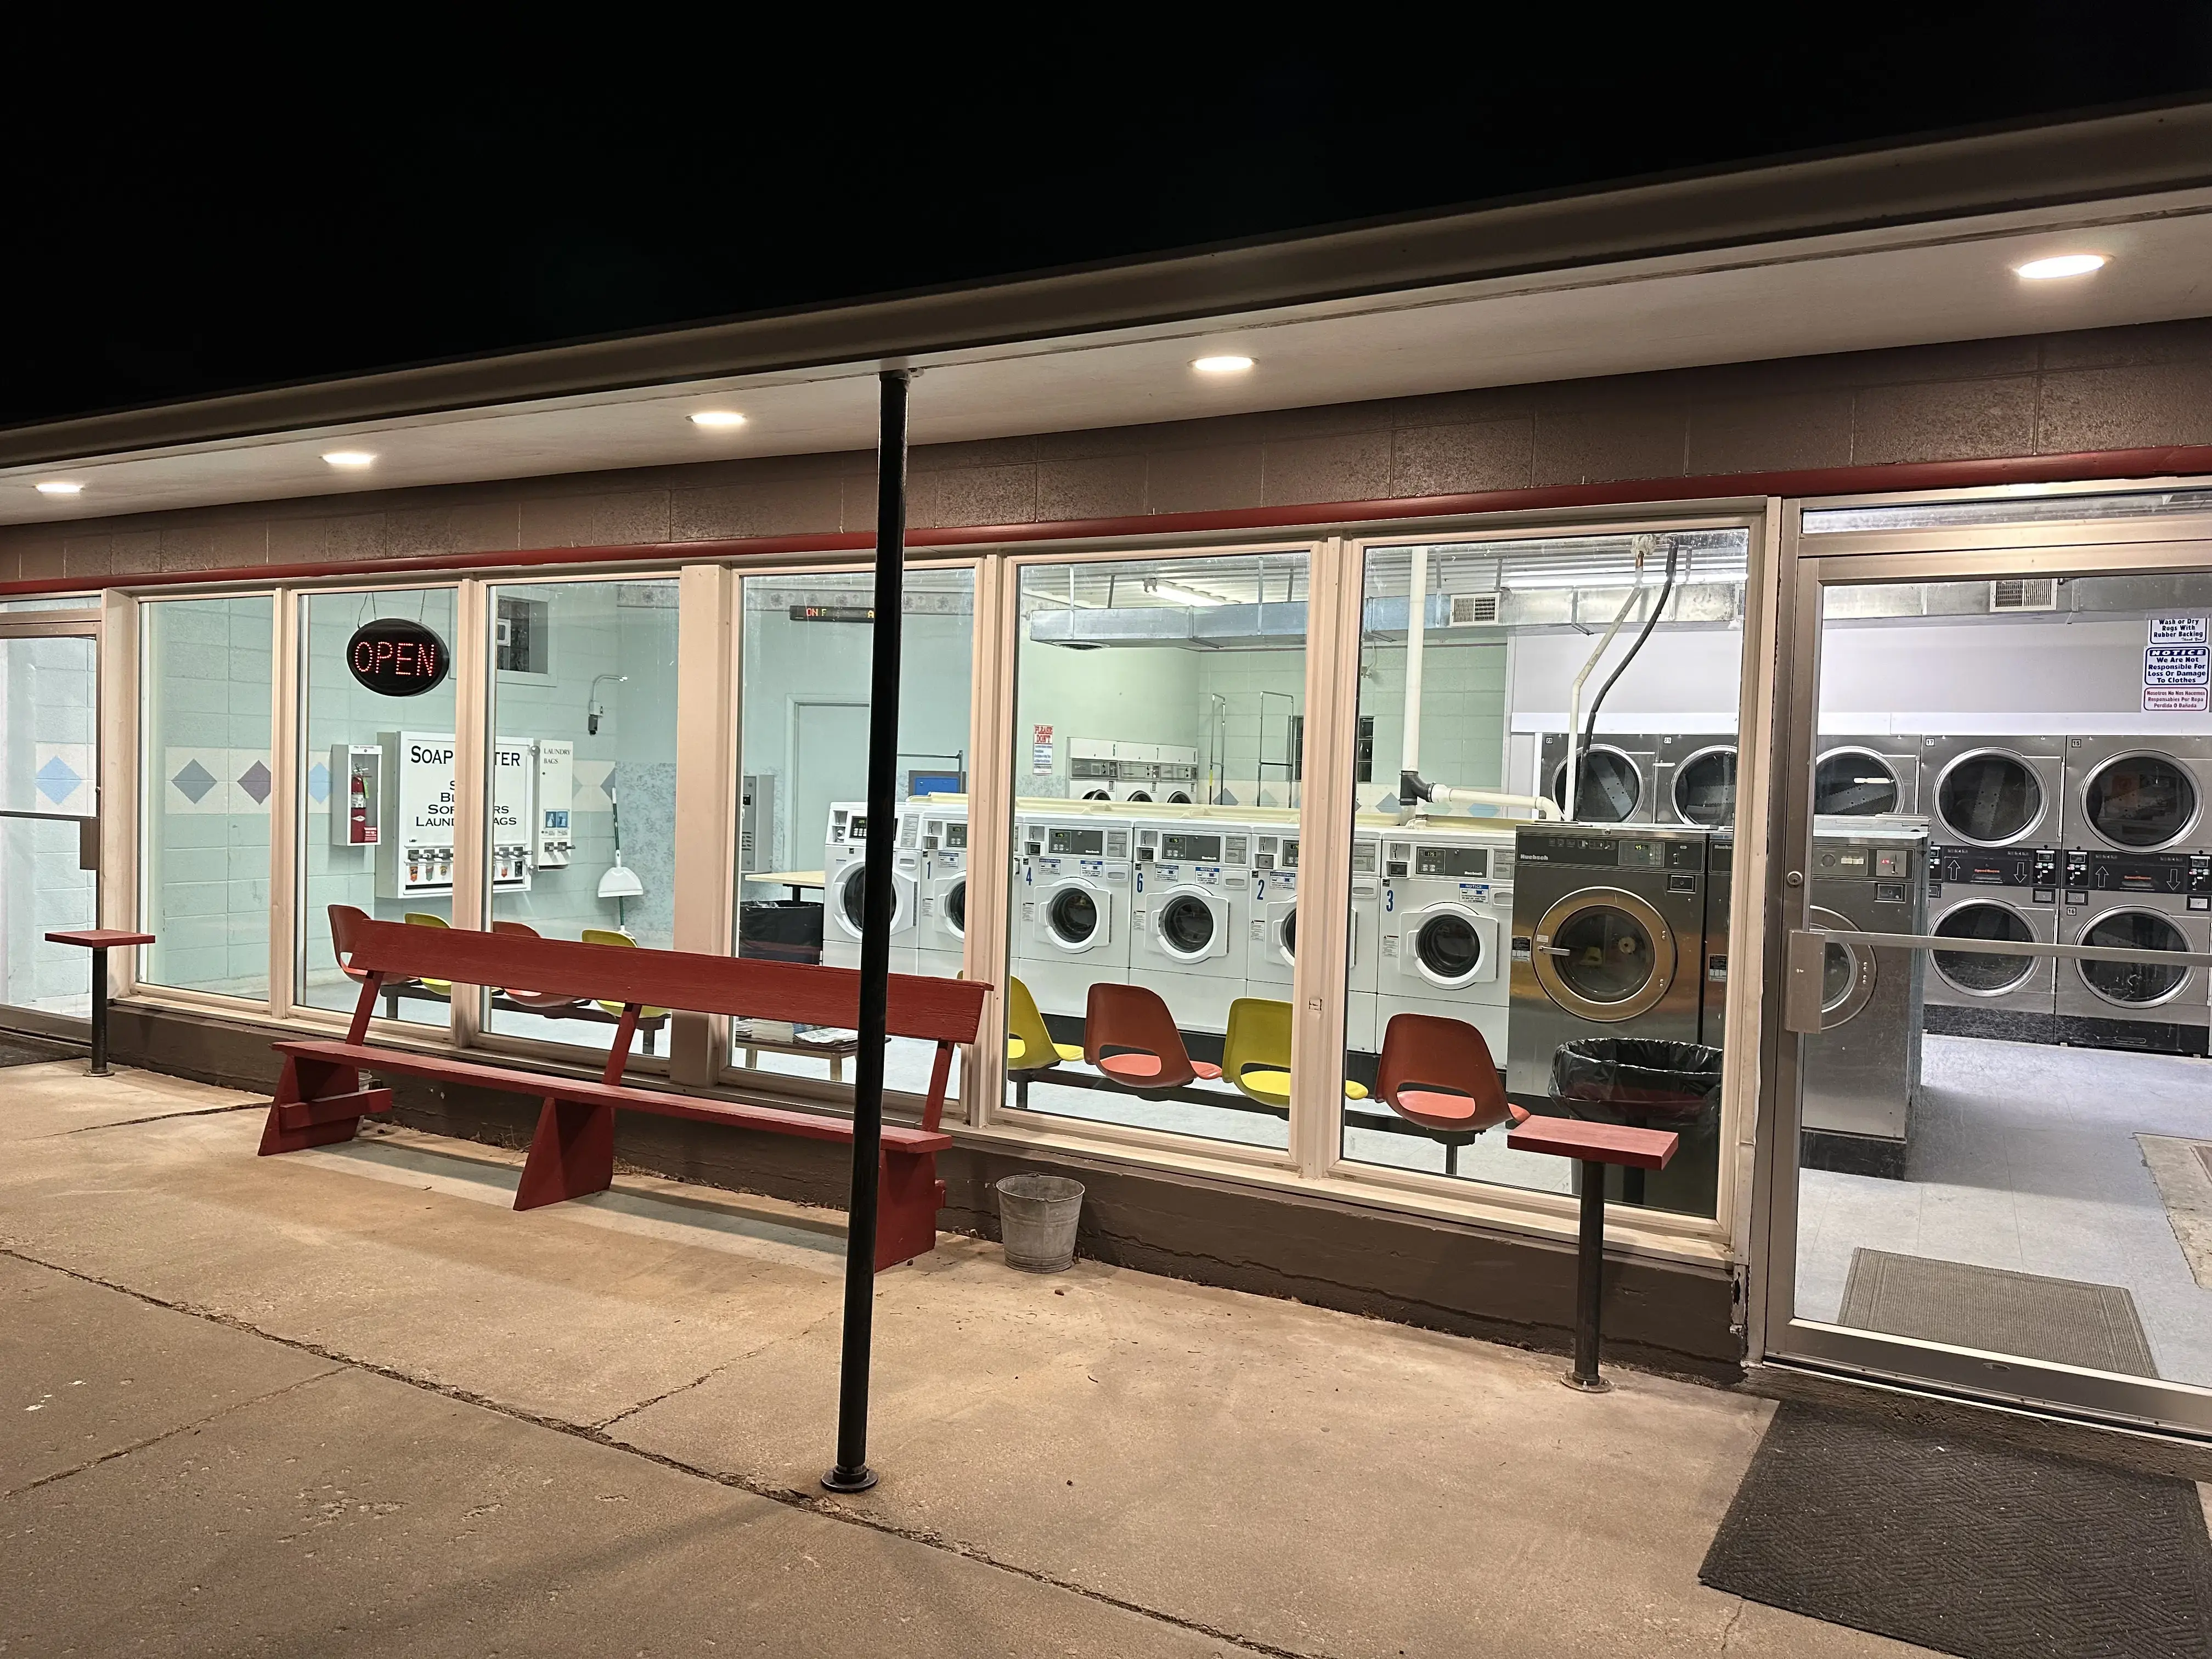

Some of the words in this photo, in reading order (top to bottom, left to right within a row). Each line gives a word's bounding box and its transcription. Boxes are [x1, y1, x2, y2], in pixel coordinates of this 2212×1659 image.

[354, 641, 435, 676] OPEN
[411, 746, 454, 764] SOAP
[927, 861, 931, 879] 1
[1026, 867, 1032, 885] 4
[1137, 873, 1143, 893] 6
[1256, 879, 1265, 900] 2
[1386, 890, 1393, 912] 3
